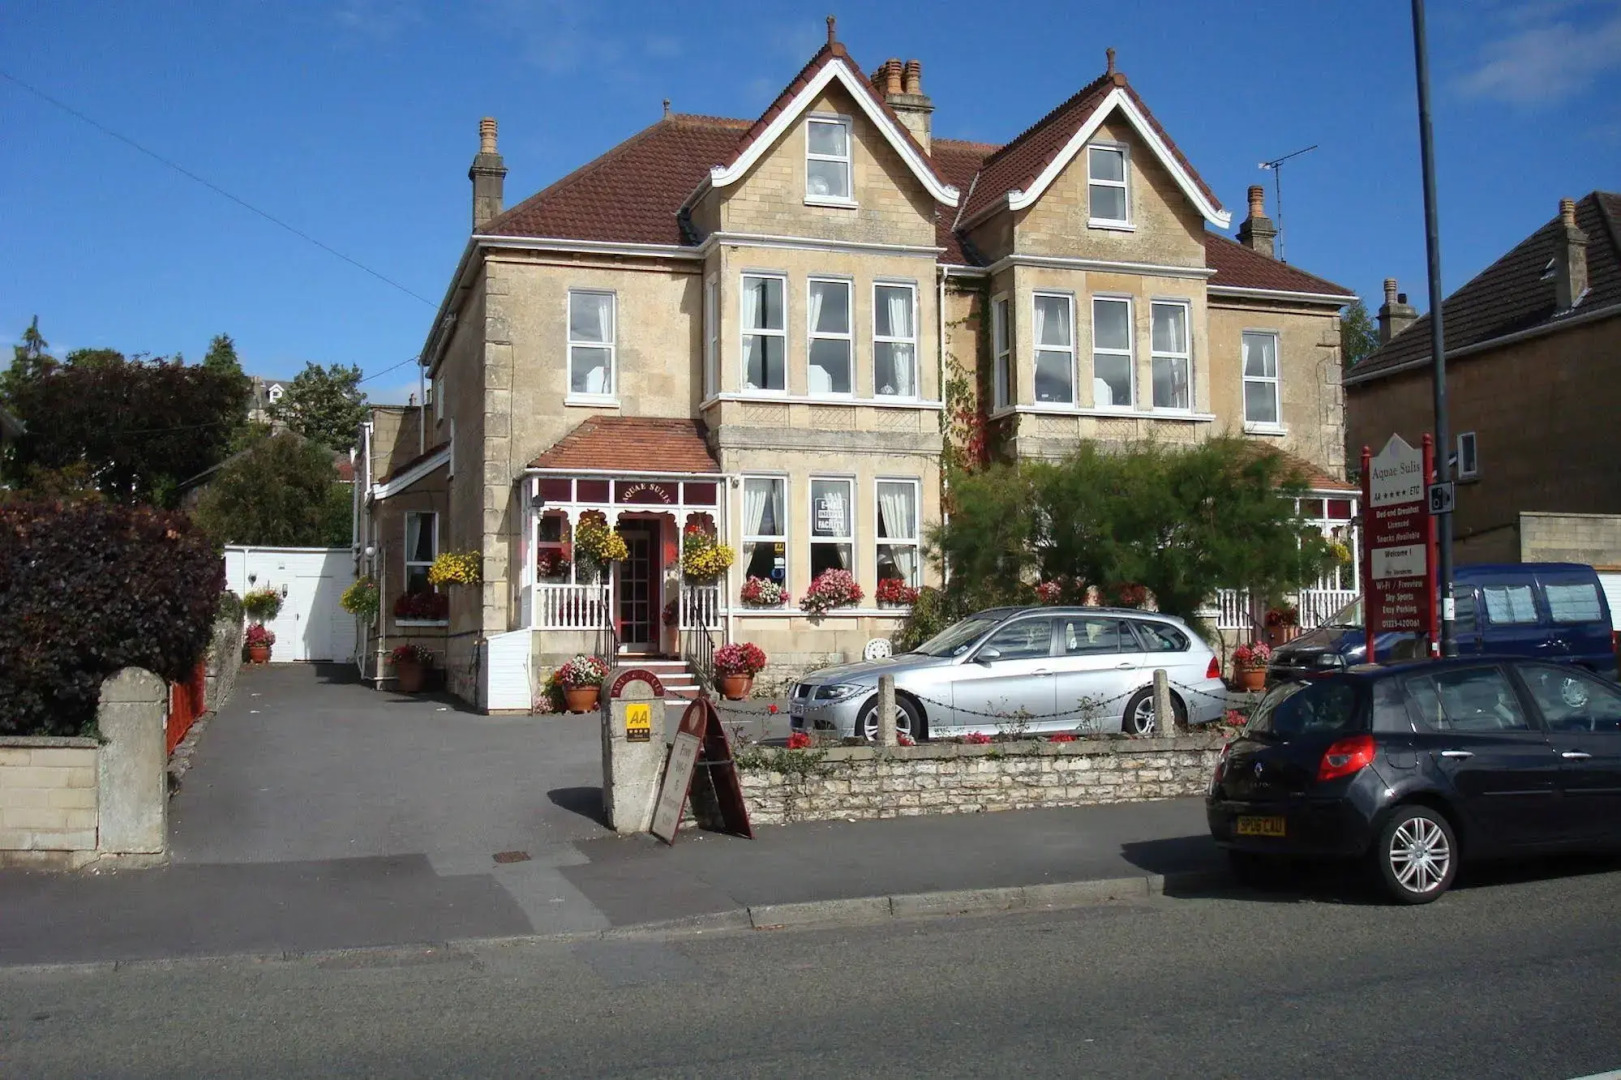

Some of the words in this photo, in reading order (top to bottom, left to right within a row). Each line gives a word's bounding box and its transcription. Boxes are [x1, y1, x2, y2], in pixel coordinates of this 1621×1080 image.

[1400, 461, 1420, 474] Sulis
[622, 483, 647, 503] AQUAE
[648, 483, 672, 503] SULIS
[1384, 549, 1408, 558] Welcome
[1396, 605, 1417, 614] Parking
[630, 711, 647, 724] AA
